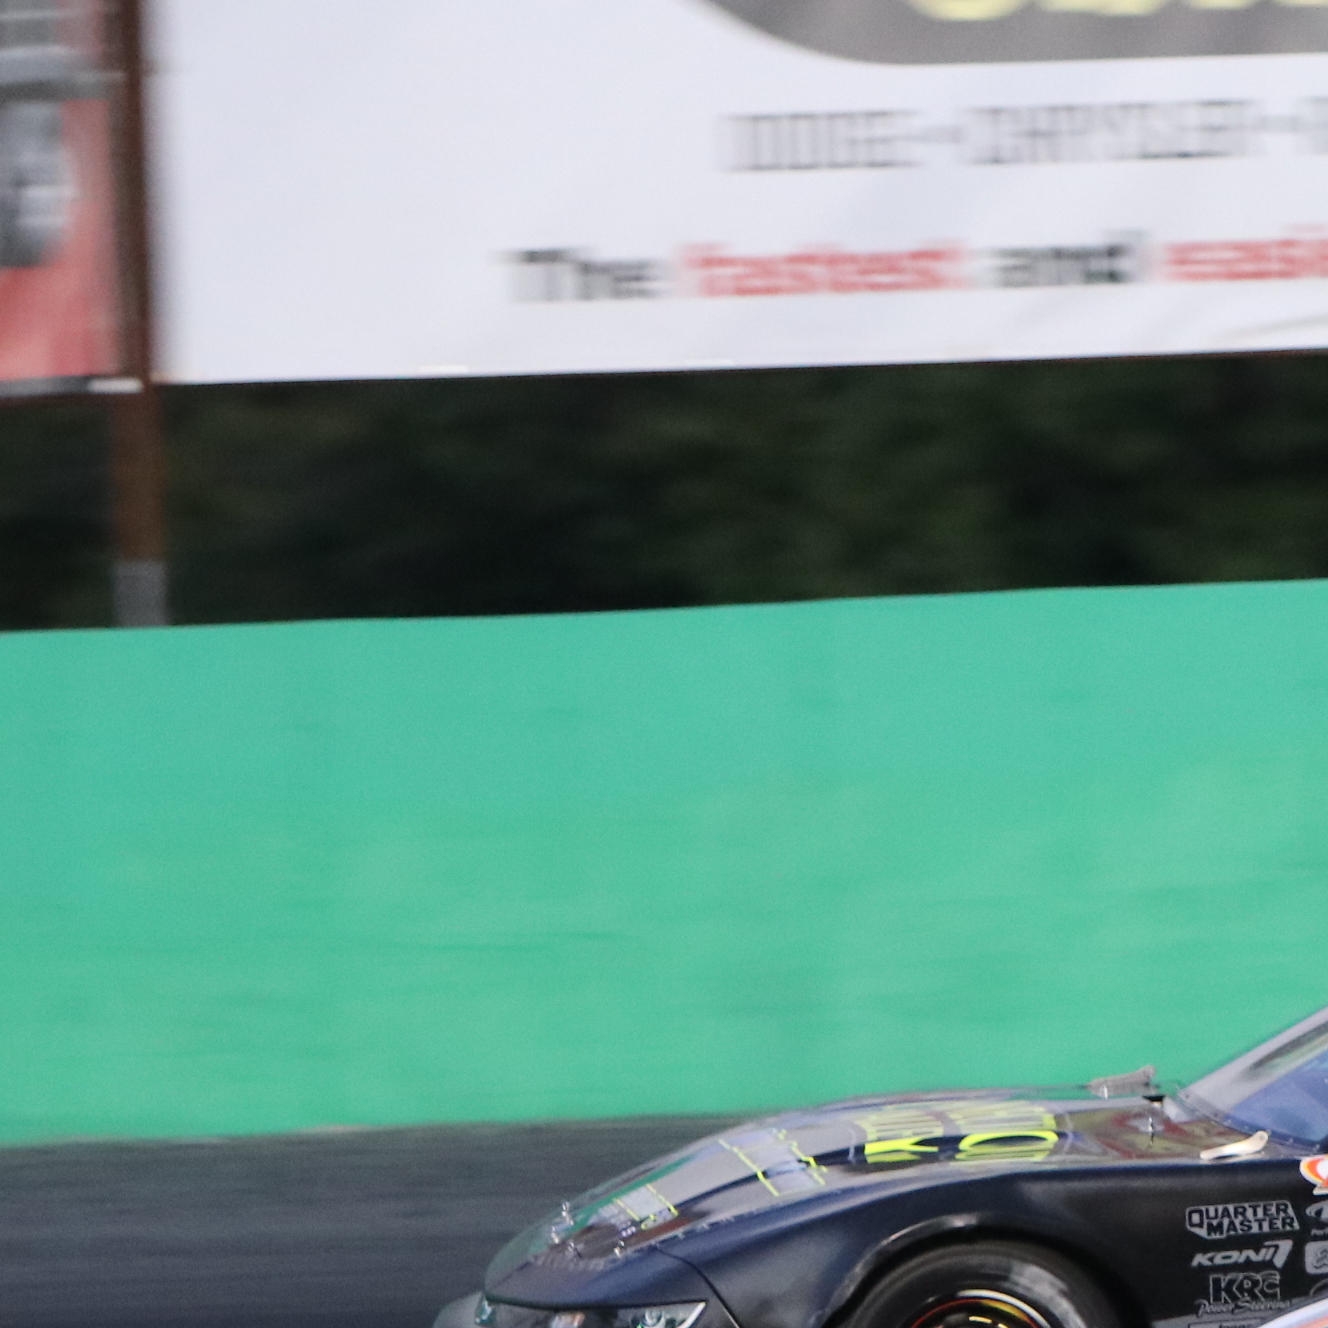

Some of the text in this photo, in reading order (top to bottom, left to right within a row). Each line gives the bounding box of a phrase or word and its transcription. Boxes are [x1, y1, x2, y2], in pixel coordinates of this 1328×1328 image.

[966, 100, 1252, 168] CHRYSLER
[510, 248, 656, 301] The
[680, 238, 962, 296] fastest
[984, 230, 1137, 288] and
[1187, 1202, 1292, 1229] QUARTER
[1206, 1214, 1299, 1238] MASTER
[1191, 1245, 1281, 1268] KONI
[1209, 1270, 1282, 1303] KRC
